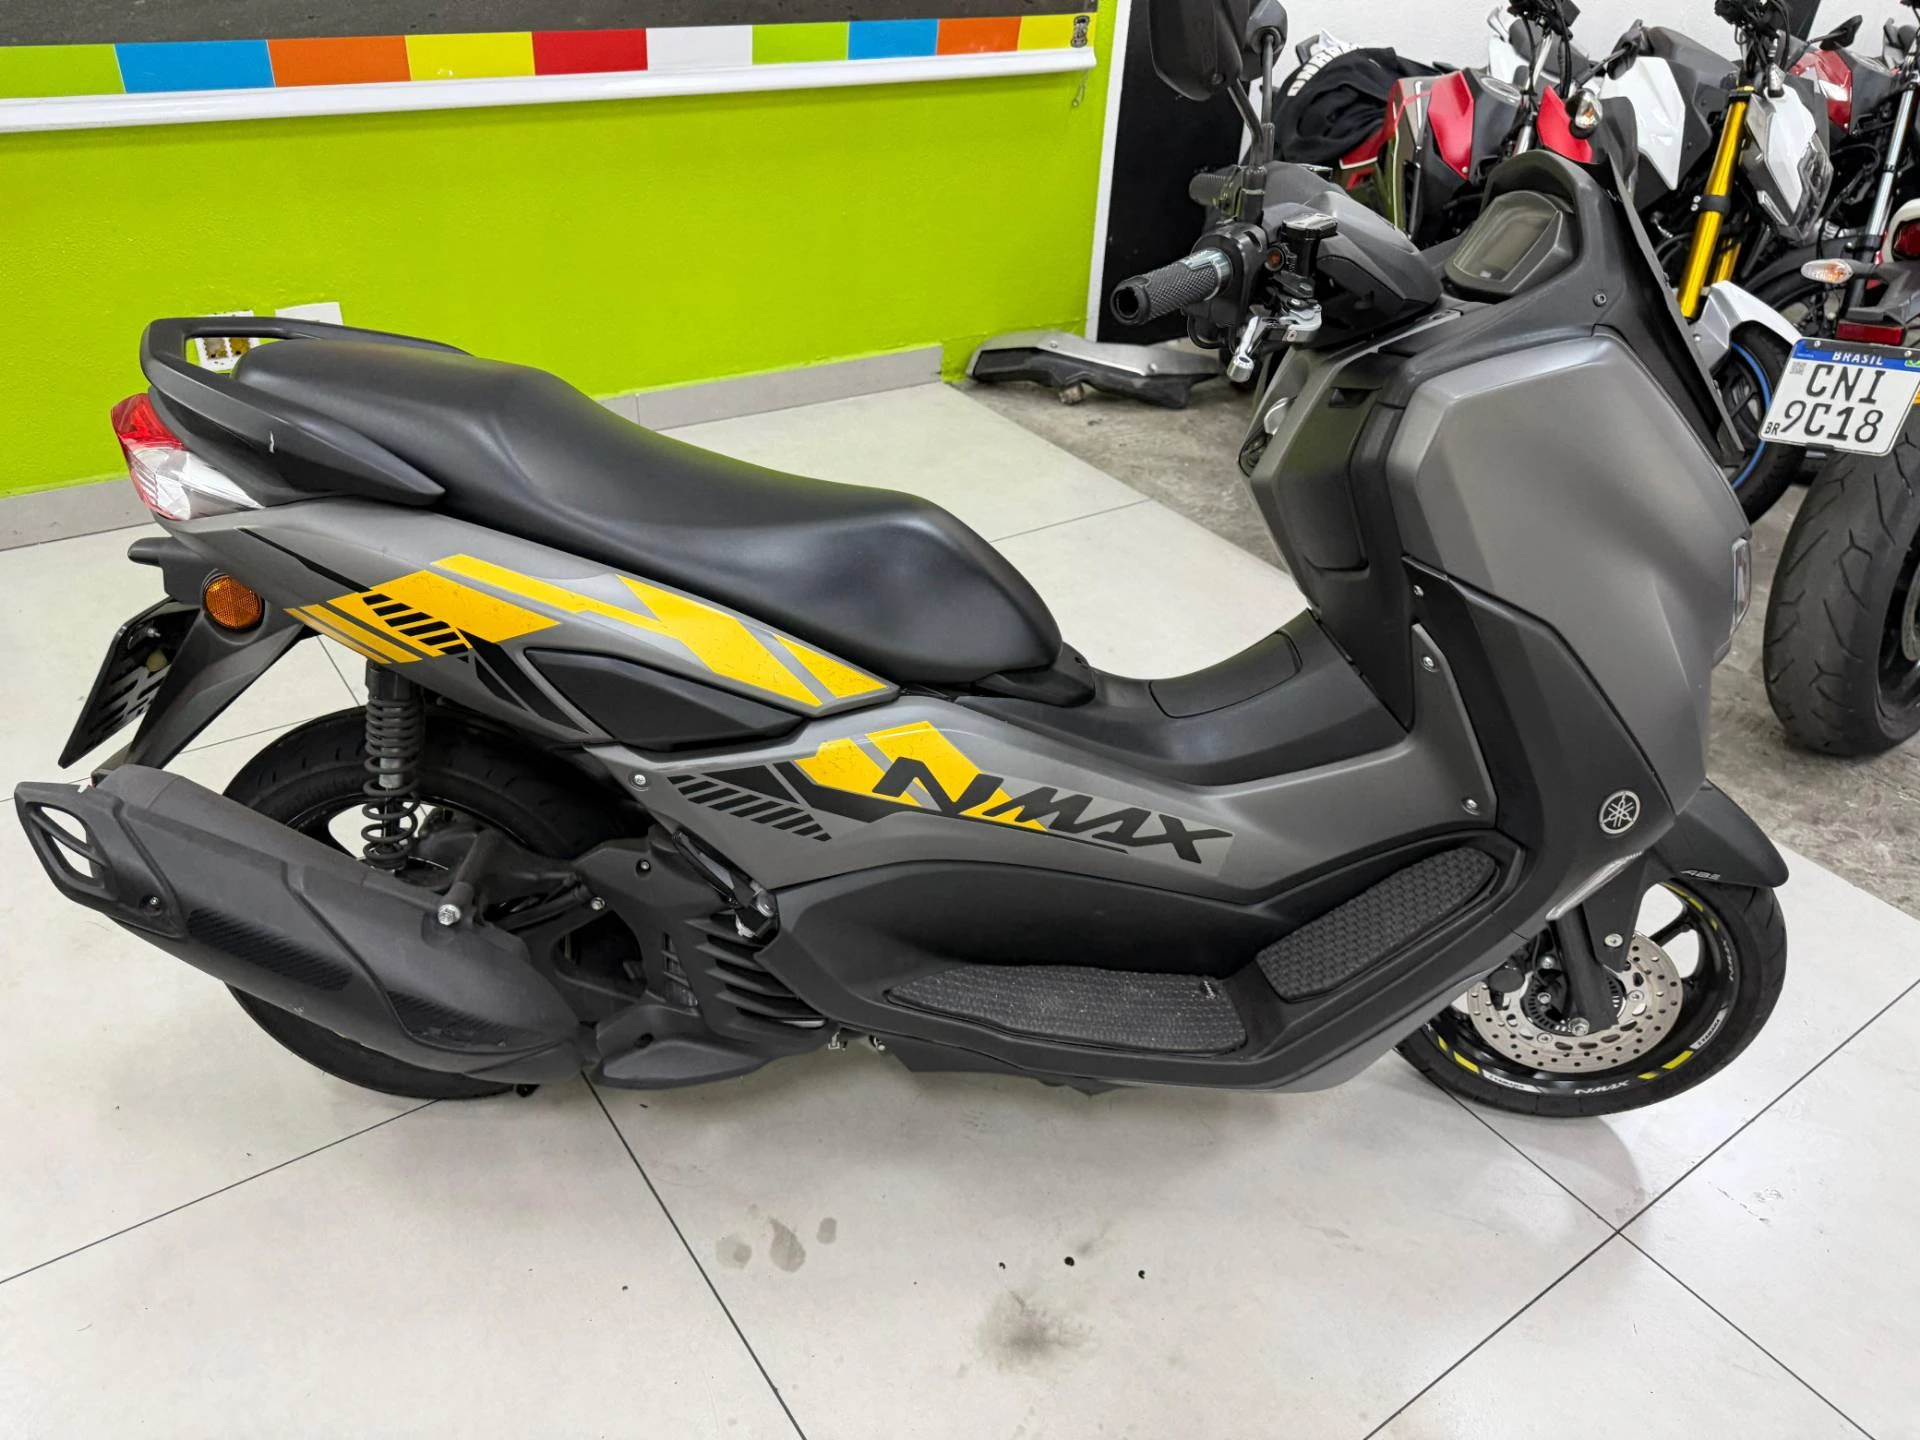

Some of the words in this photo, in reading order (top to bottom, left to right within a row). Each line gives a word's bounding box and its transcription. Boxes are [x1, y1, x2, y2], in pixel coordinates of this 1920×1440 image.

[1832, 352, 1884, 365] BRASIL
[1806, 364, 1886, 404] CNI
[1764, 422, 1780, 436] BR
[1780, 400, 1884, 443] 9C18
[872, 756, 1233, 864] NMAX
